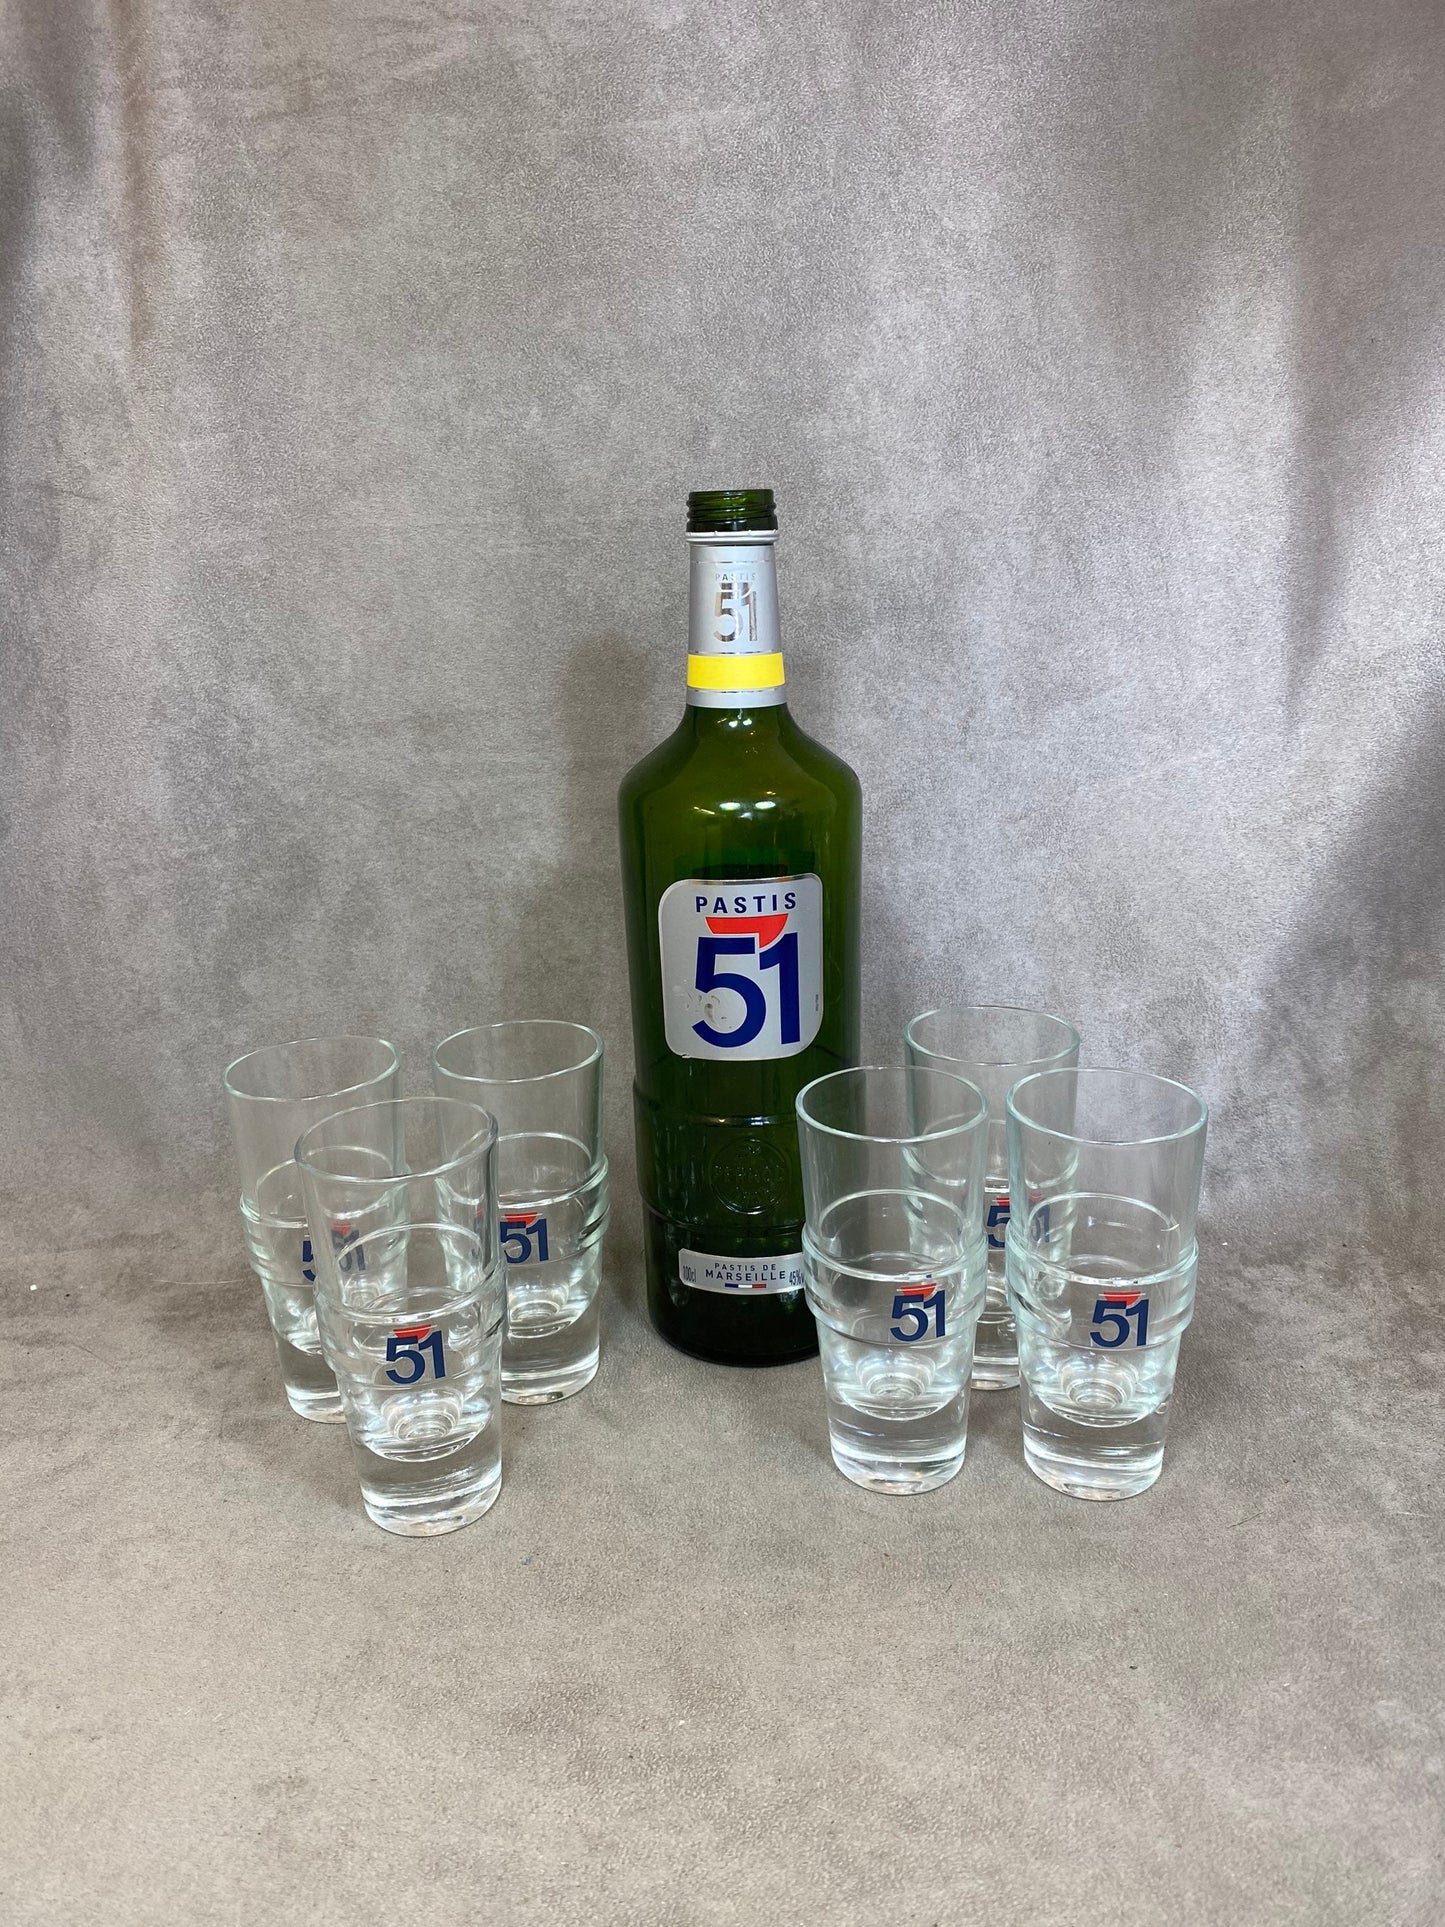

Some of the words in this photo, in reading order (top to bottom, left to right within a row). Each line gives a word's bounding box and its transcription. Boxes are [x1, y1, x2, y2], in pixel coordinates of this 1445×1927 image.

[713, 589, 758, 642] 51
[695, 892, 796, 914] PASTIS
[692, 932, 800, 1047] 51
[500, 1218, 549, 1264] 51
[705, 1269, 786, 1282] MARSEILLE
[714, 1263, 756, 1272] PASTIS
[763, 1263, 777, 1271] DE
[890, 1290, 946, 1341] 51
[1090, 1299, 1149, 1348] 51
[386, 1330, 446, 1384] 51
